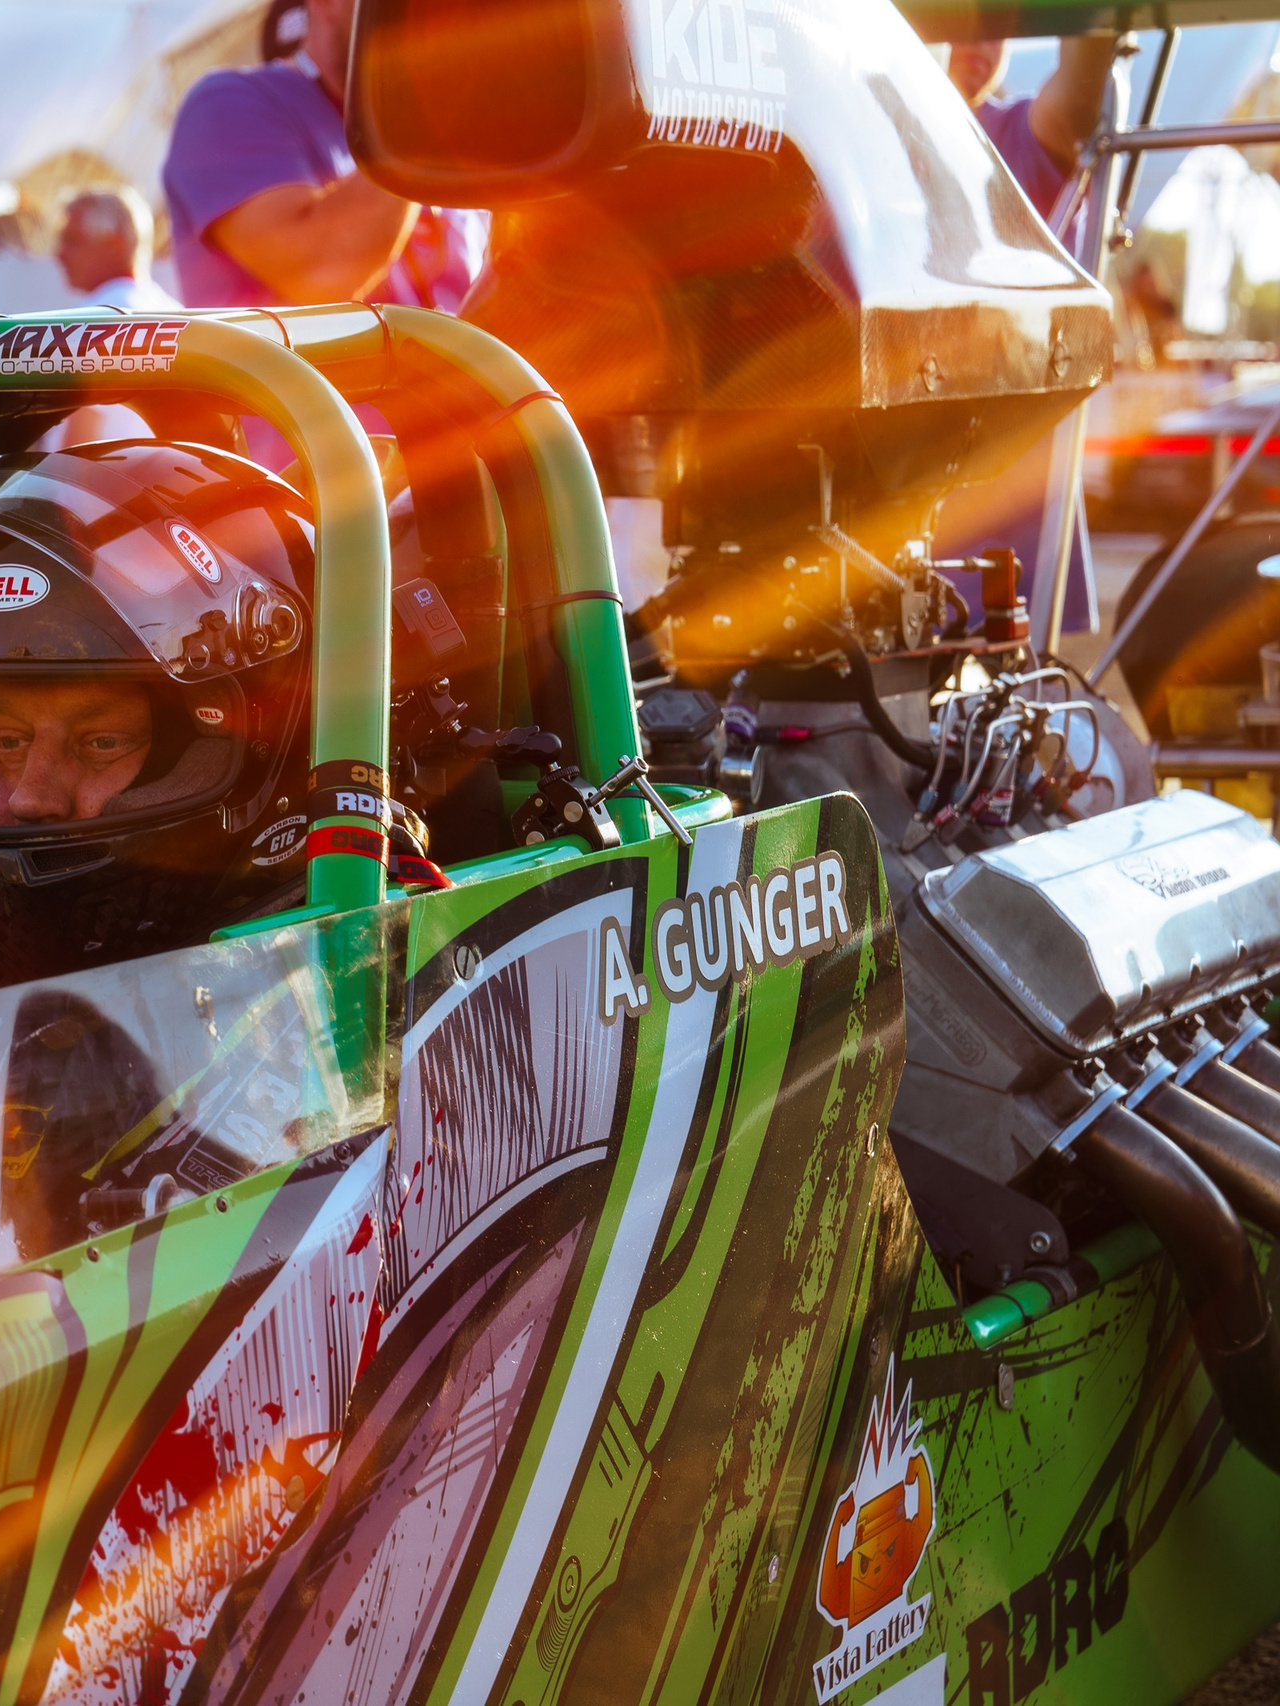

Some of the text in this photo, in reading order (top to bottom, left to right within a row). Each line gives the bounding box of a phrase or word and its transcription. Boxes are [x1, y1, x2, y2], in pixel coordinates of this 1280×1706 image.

[647, 85, 787, 153] MOTORSPORT
[177, 529, 213, 575] BELL
[414, 588, 431, 604] 10
[198, 710, 221, 720] BELL
[264, 816, 301, 837] CARBON
[605, 858, 849, 1017] A. GUNGER
[816, 1599, 929, 1697] Vista Battery
